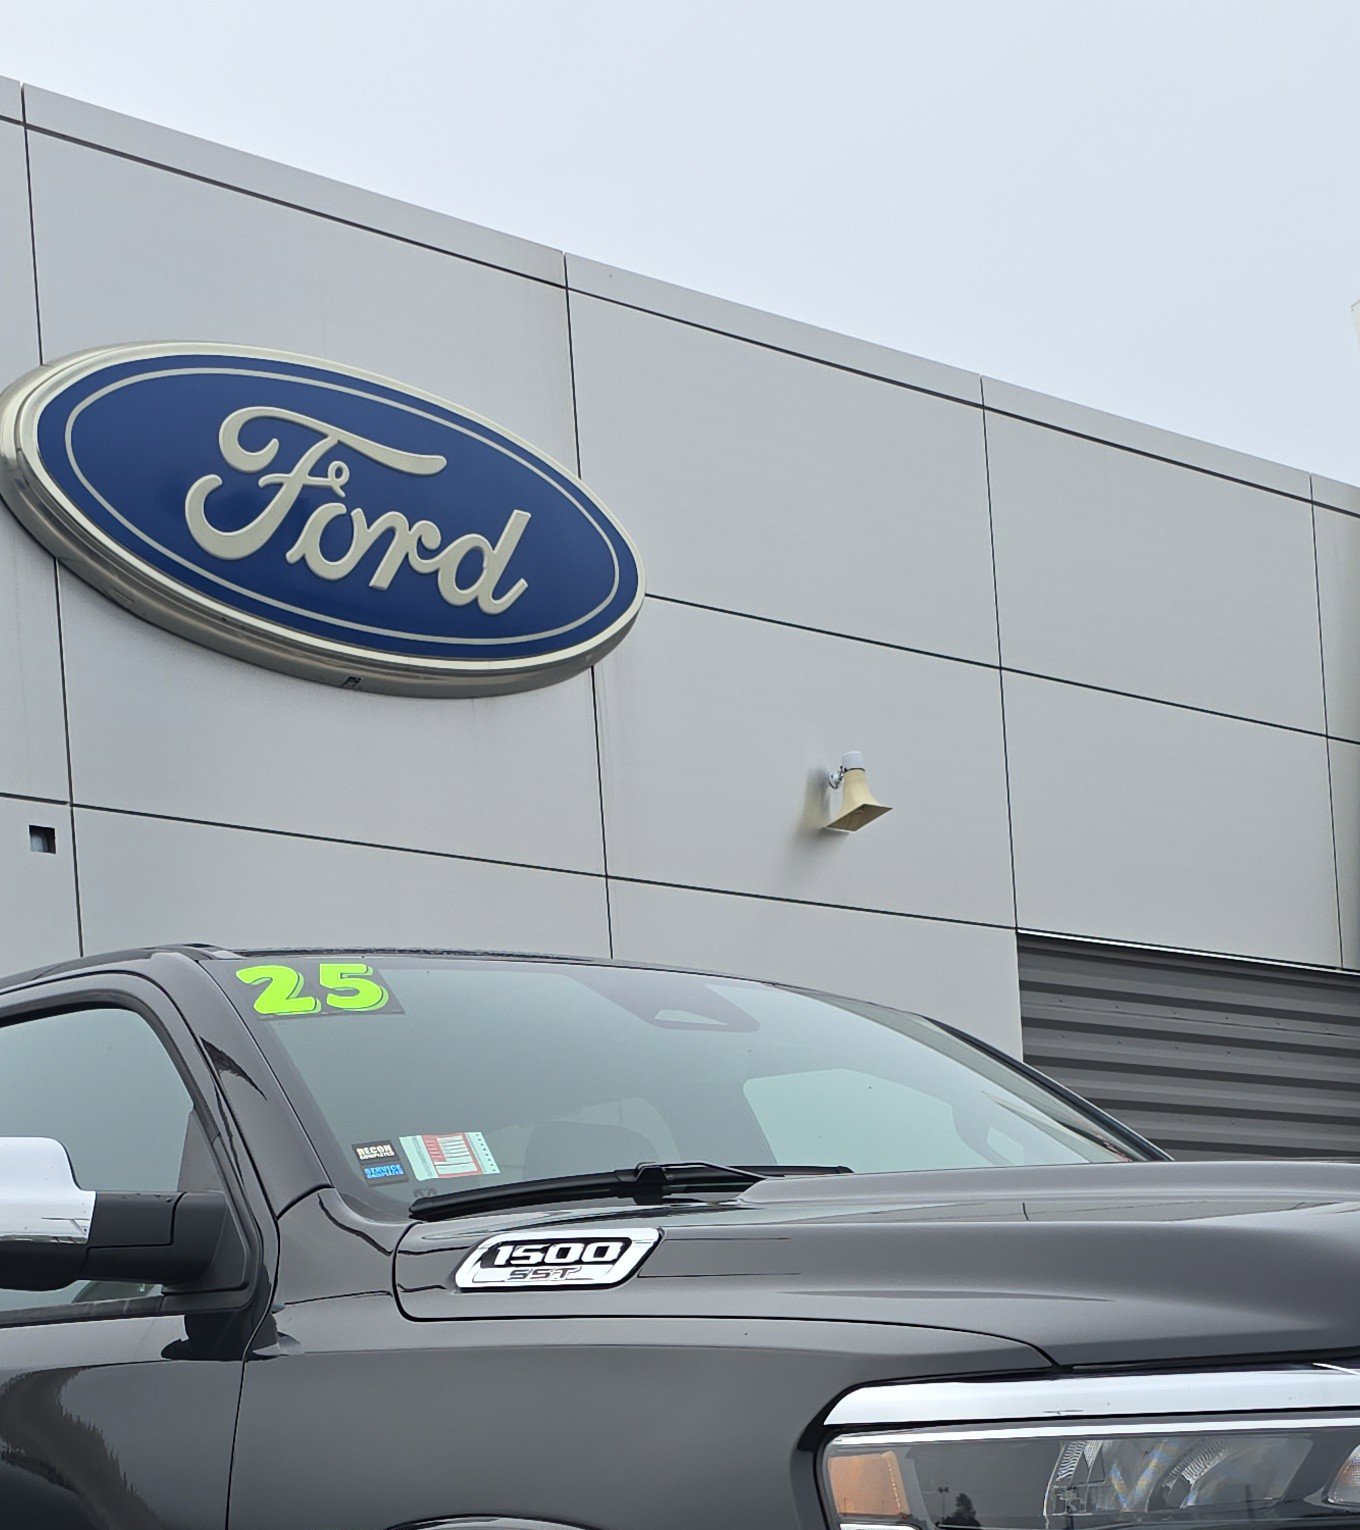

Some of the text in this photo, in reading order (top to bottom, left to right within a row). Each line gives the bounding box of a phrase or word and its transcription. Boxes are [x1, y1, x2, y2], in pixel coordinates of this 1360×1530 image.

[185, 405, 532, 615] Ford
[235, 963, 390, 1016] 25
[493, 1241, 624, 1267] 1500
[508, 1266, 579, 1281] SST
